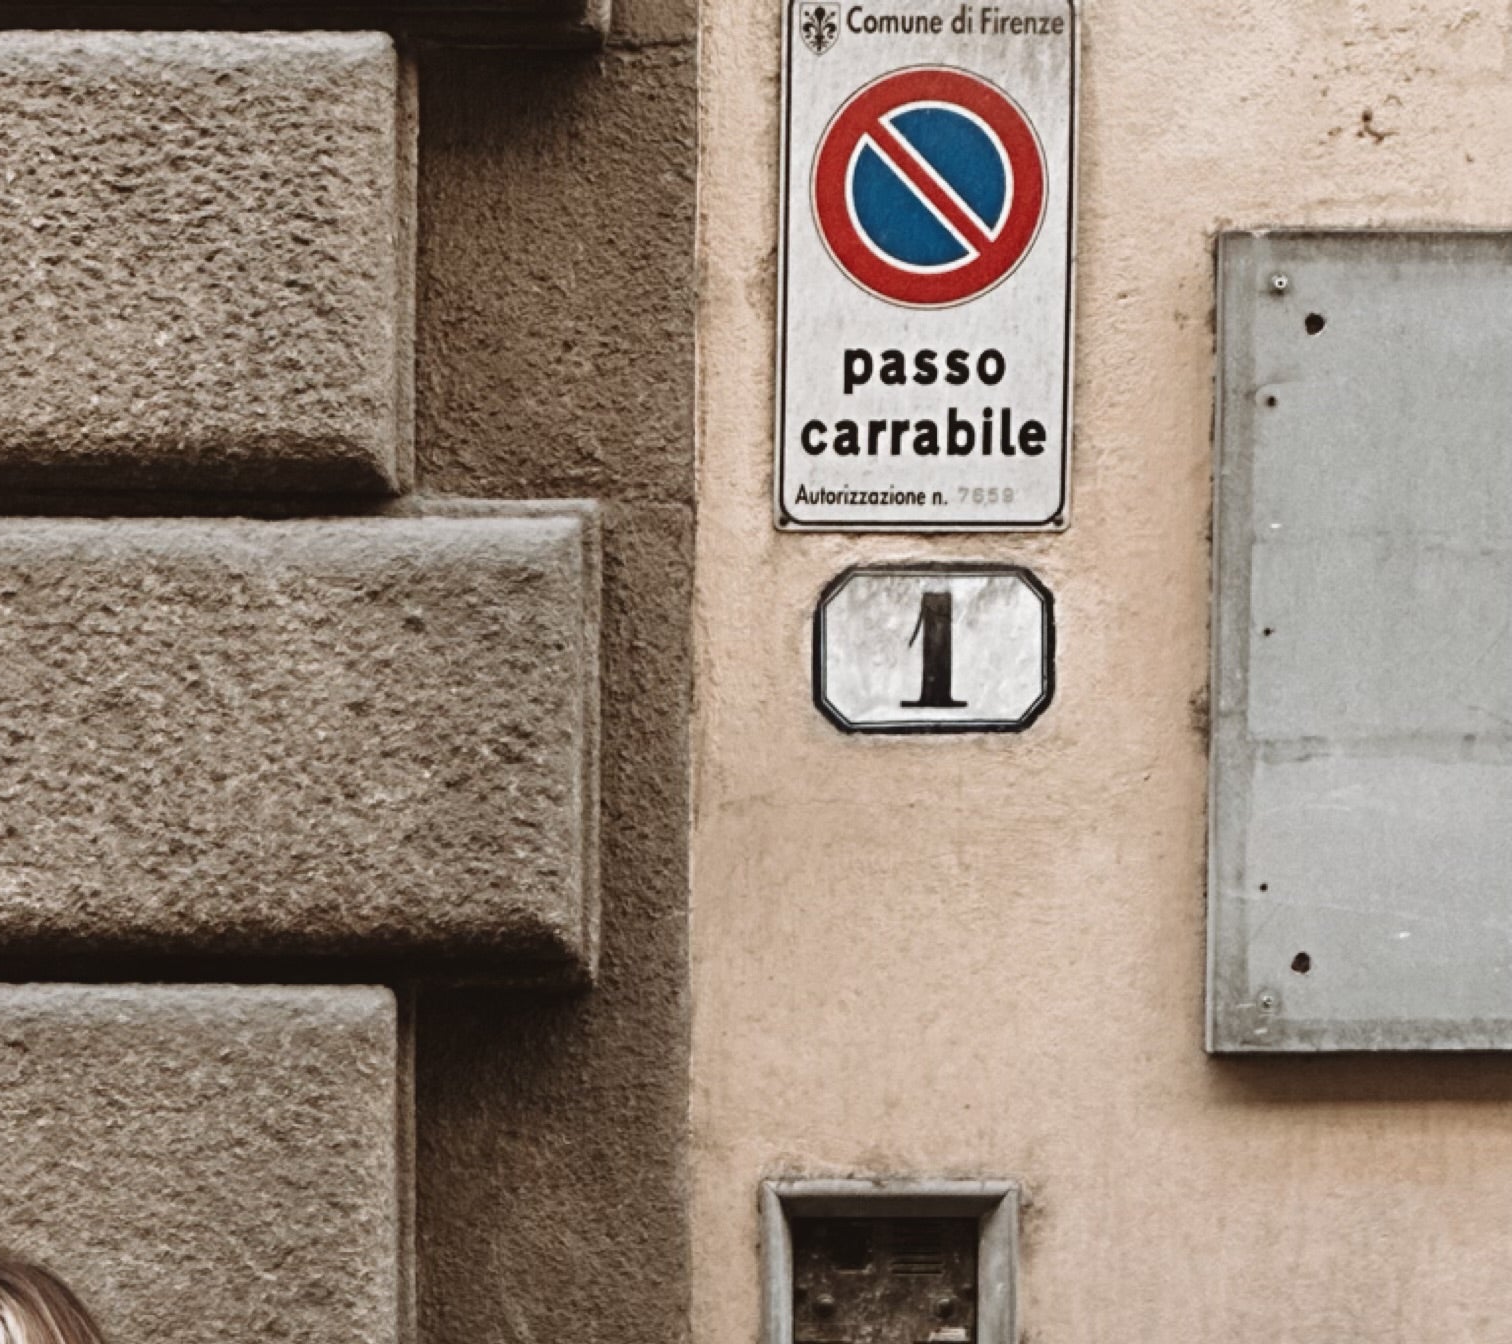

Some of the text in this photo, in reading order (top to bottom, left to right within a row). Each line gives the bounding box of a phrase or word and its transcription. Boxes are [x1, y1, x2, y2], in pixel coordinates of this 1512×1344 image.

[846, 4, 1065, 34] Comune di Firenze
[843, 348, 1006, 395] passo
[801, 406, 1047, 456] carrabile
[795, 483, 926, 505] Autorizzazione
[932, 491, 948, 505] n.
[899, 591, 968, 708] 1
